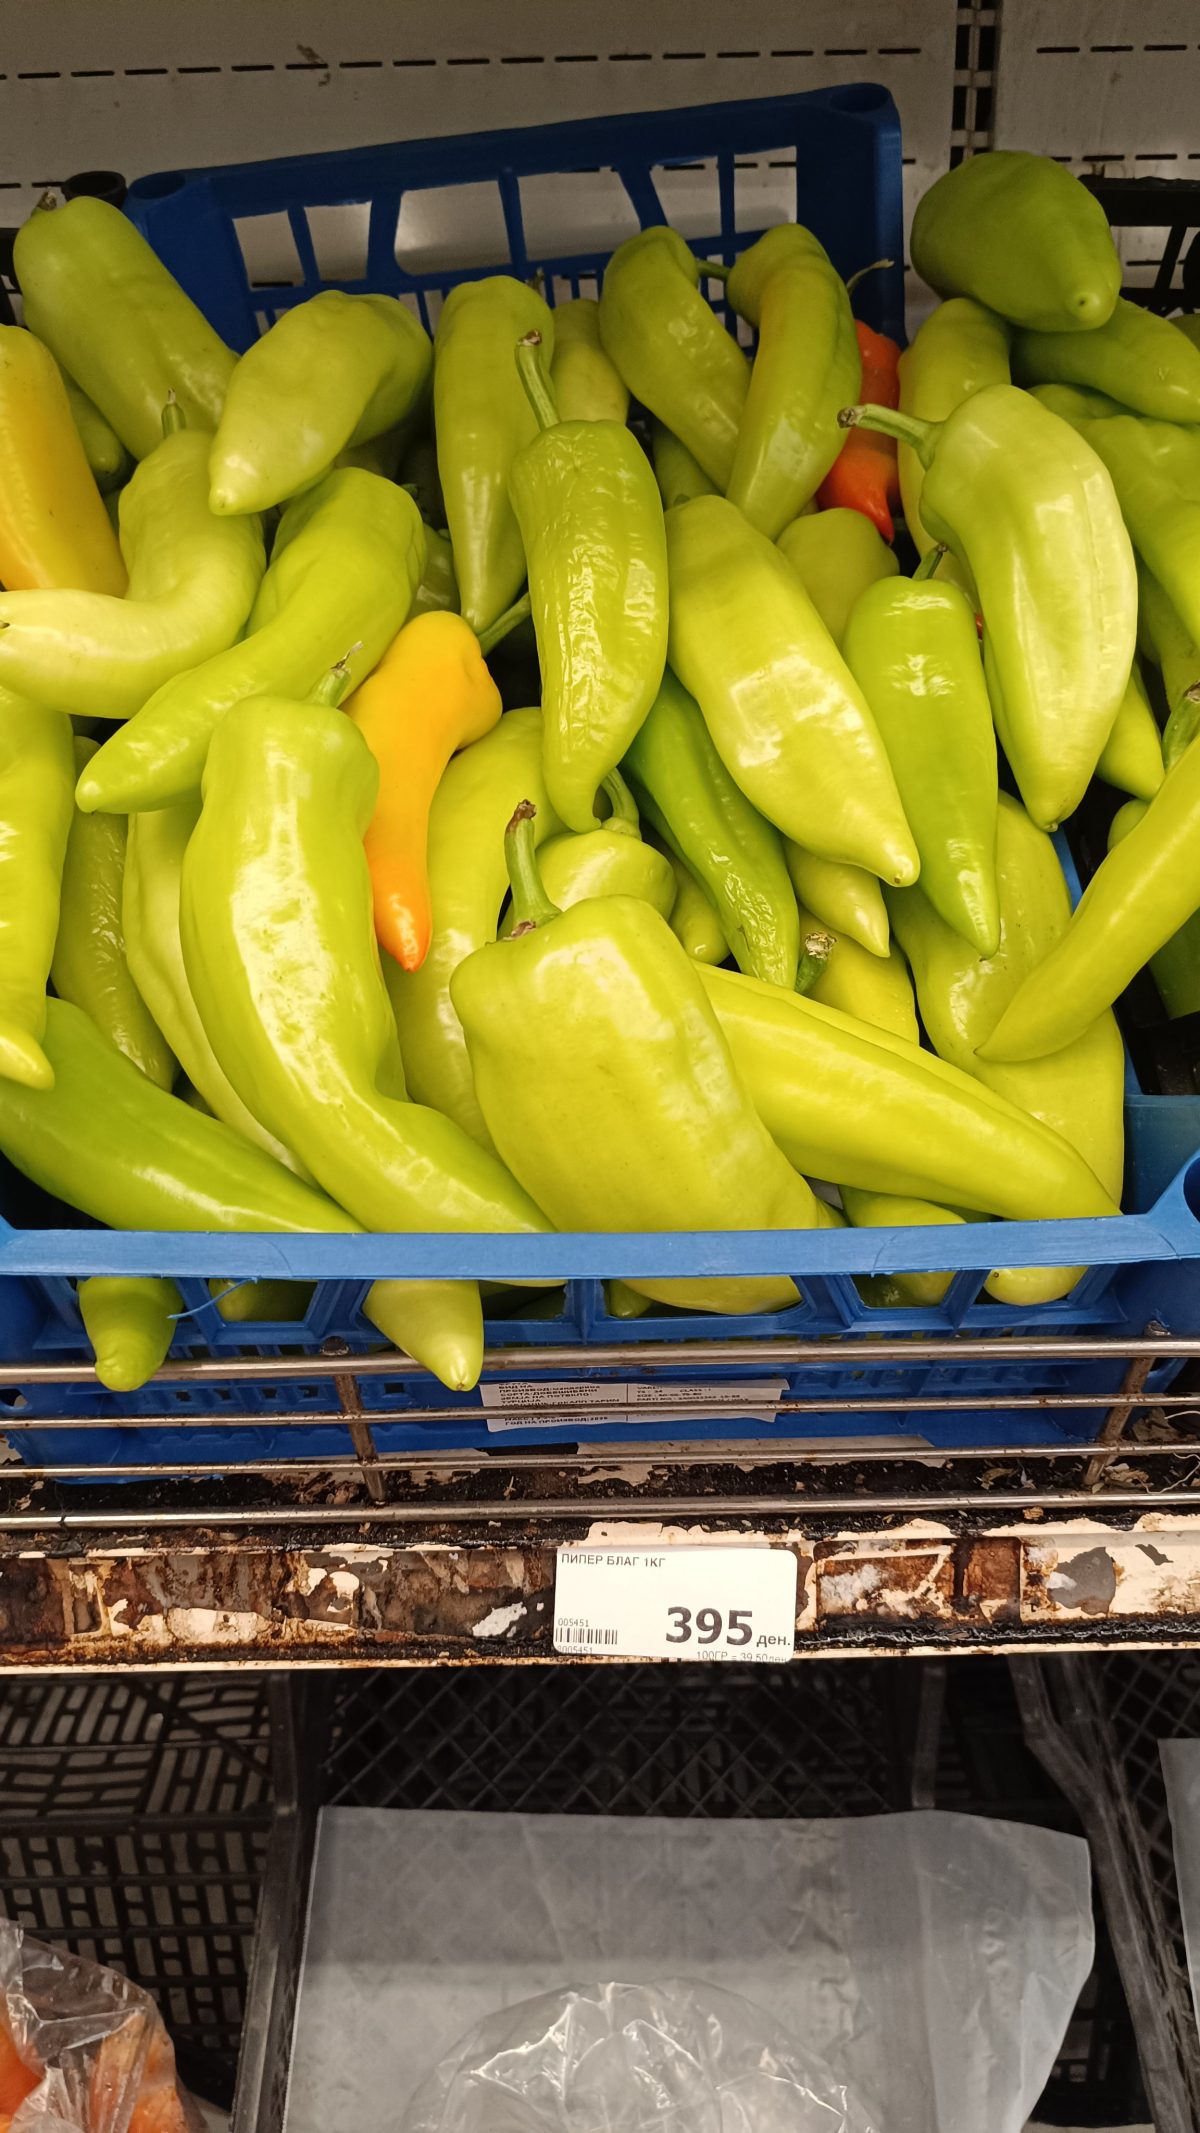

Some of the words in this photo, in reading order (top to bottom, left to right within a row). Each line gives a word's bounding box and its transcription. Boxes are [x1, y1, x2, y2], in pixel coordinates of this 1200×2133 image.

[561, 1553, 604, 1565] ПИПЕР
[606, 1555, 640, 1567] БЛАГ
[644, 1557, 666, 1568] 1КГ
[557, 1617, 589, 1628] 005451
[665, 1606, 753, 1646] 395
[756, 1635, 791, 1648] ден.
